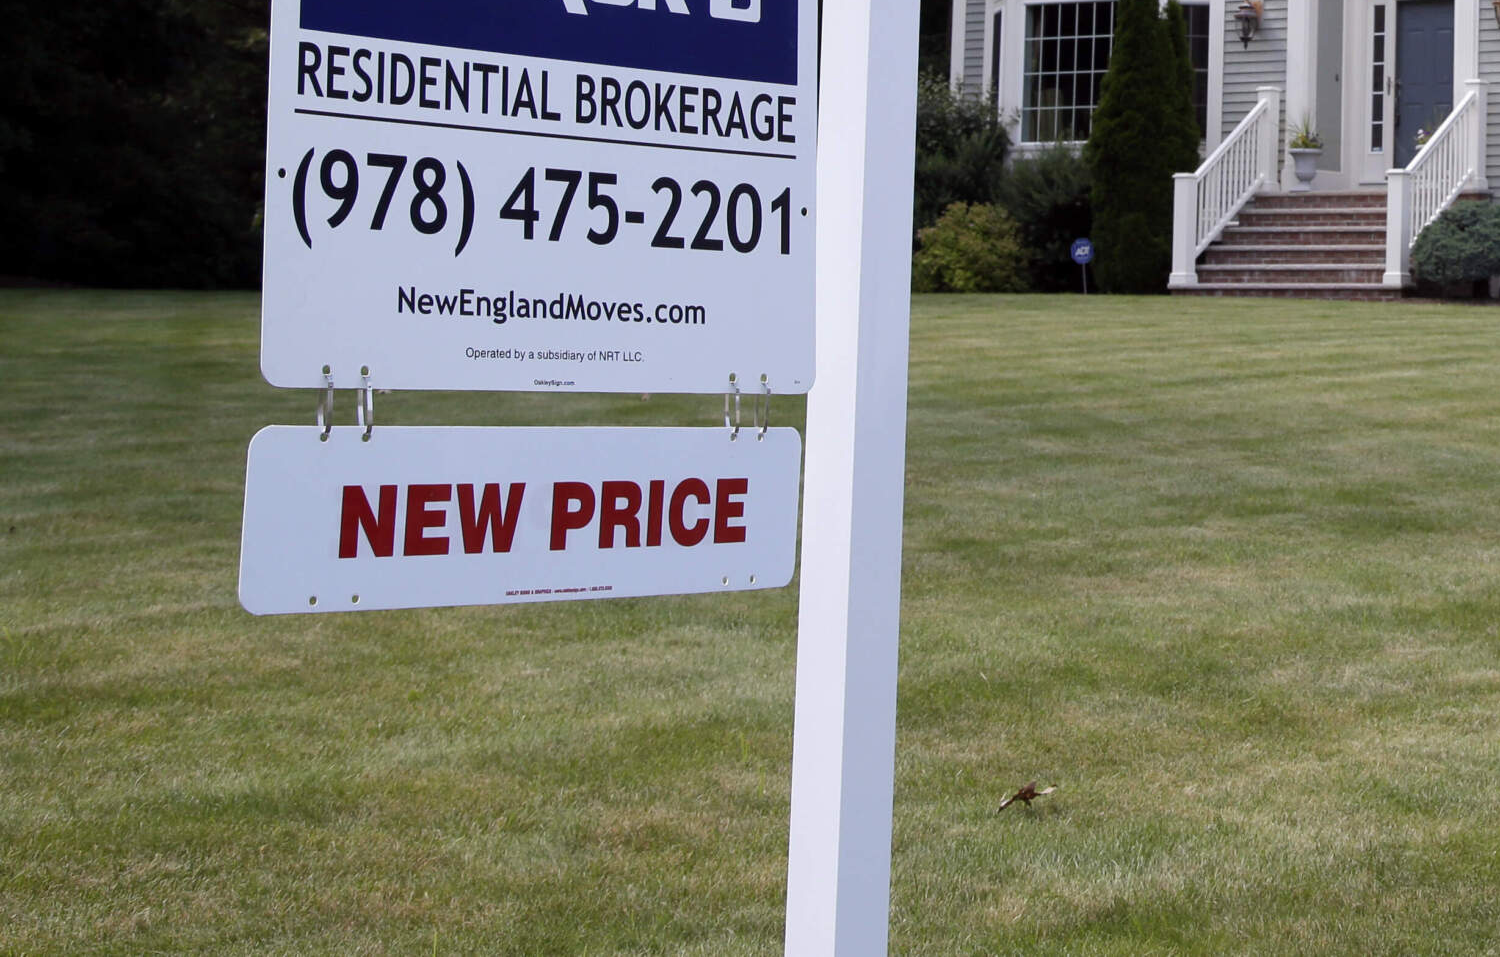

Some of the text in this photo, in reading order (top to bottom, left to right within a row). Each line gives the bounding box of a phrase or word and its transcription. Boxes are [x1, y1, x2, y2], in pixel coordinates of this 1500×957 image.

[297, 41, 797, 144] RESIDENTIAL BROKERAGE
[292, 146, 791, 258] (978) 475-2201
[397, 285, 707, 326] NewEnglandMoves.com
[465, 347, 645, 363] Operated by a subsidiary of NRT LLC.
[337, 477, 749, 560] NEW PRICE
